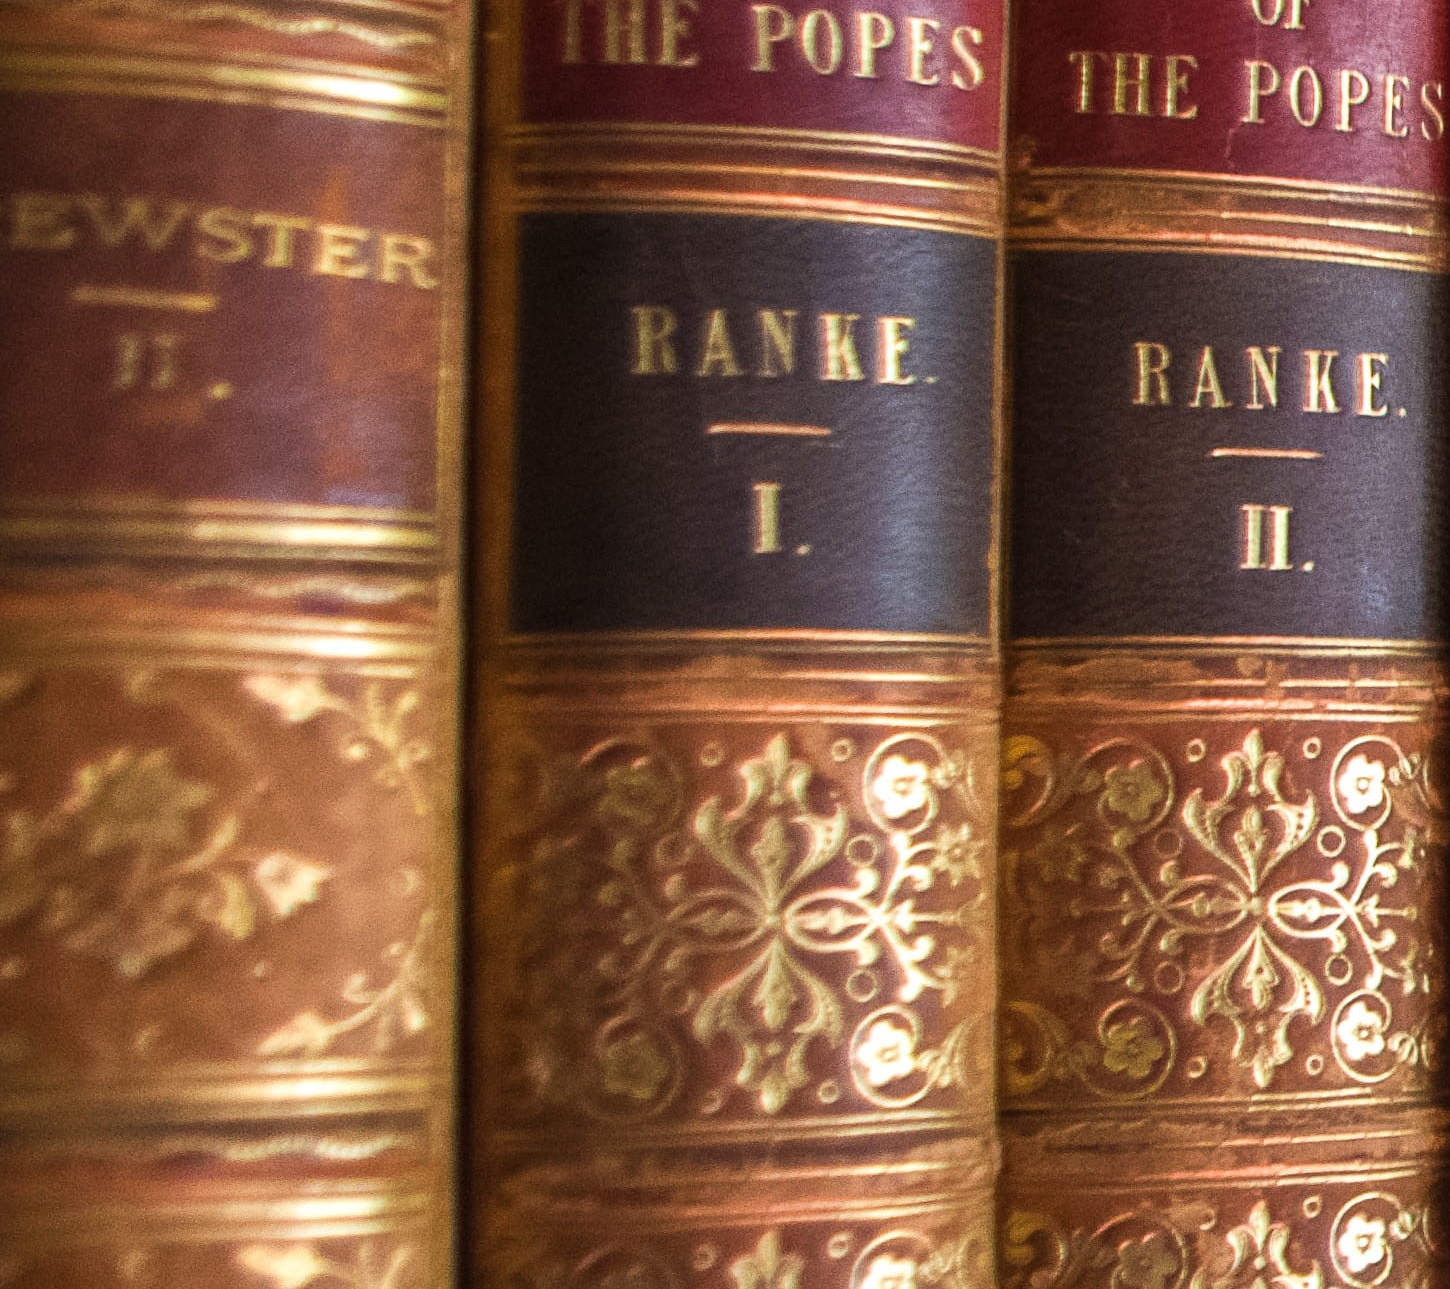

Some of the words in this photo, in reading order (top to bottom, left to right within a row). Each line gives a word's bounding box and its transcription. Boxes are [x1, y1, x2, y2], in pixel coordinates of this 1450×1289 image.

[749, 3, 985, 91] POPES
[1069, 50, 1199, 119] THE
[1239, 60, 1445, 141] POPES
[8, 191, 438, 289] EWSTER
[631, 306, 938, 385] RANKE.
[1133, 342, 1407, 417] RANKE.
[752, 481, 811, 554] I.
[1239, 504, 1315, 571] II.
